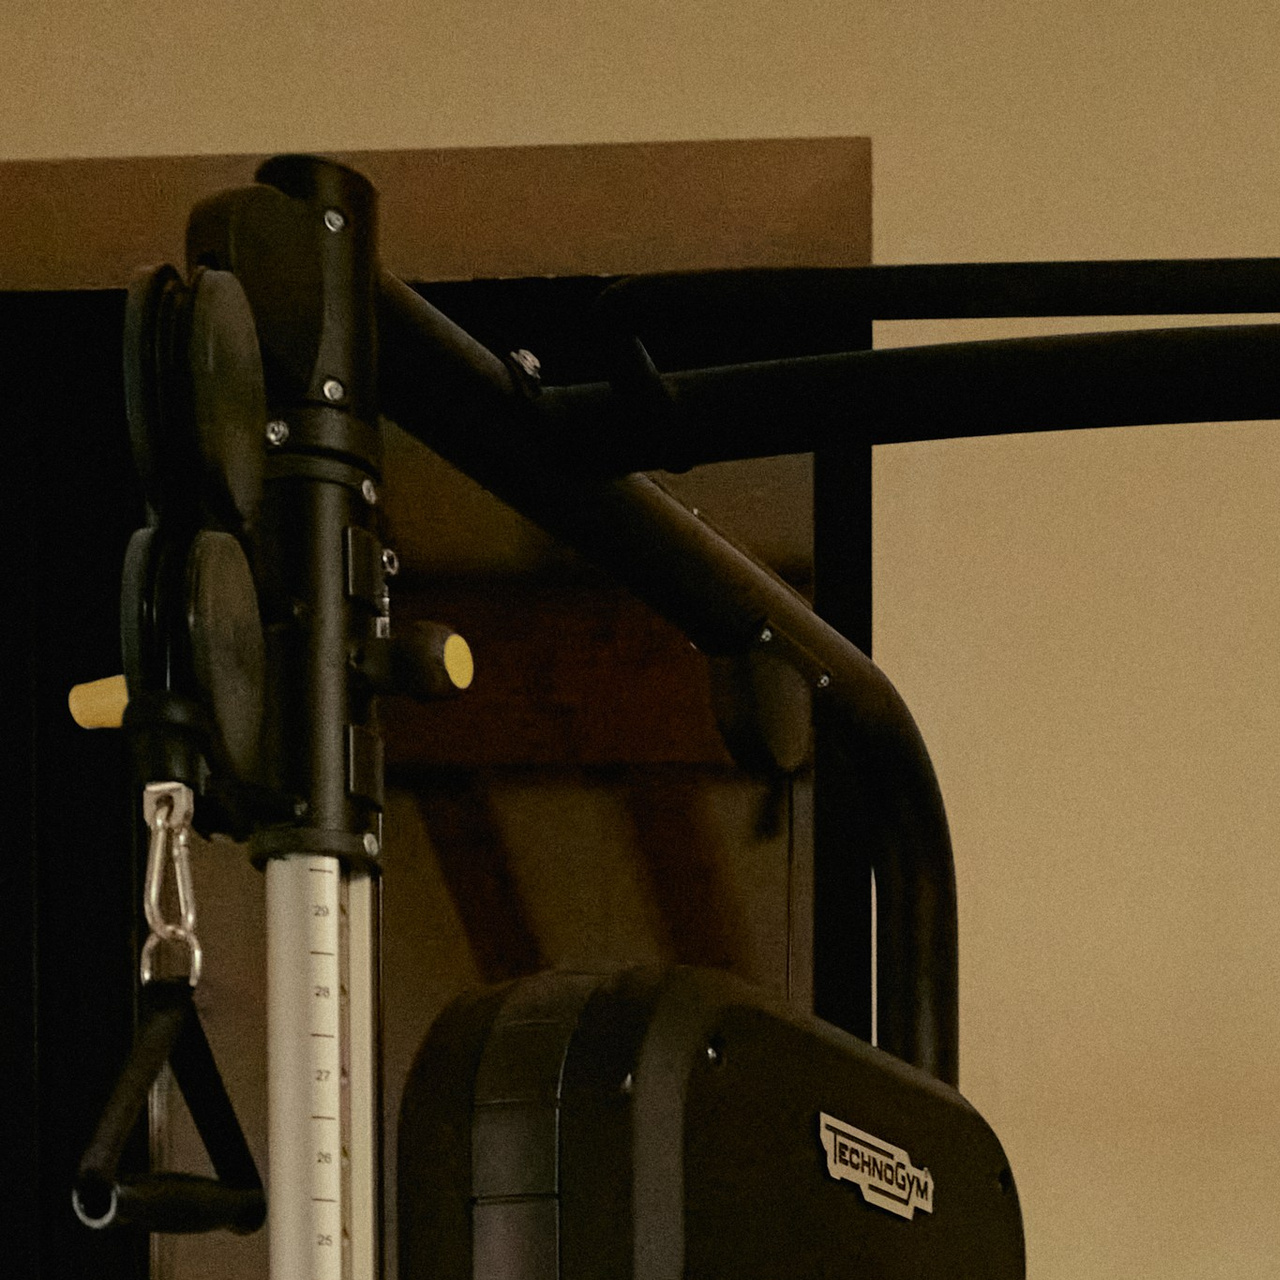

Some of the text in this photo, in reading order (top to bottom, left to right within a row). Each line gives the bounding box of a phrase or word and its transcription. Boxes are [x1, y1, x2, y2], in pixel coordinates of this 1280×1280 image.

[313, 905, 330, 917] 29
[315, 986, 330, 999] 28
[315, 1069, 331, 1082] 27
[317, 1151, 332, 1164] 26
[317, 1234, 333, 1246] 25
